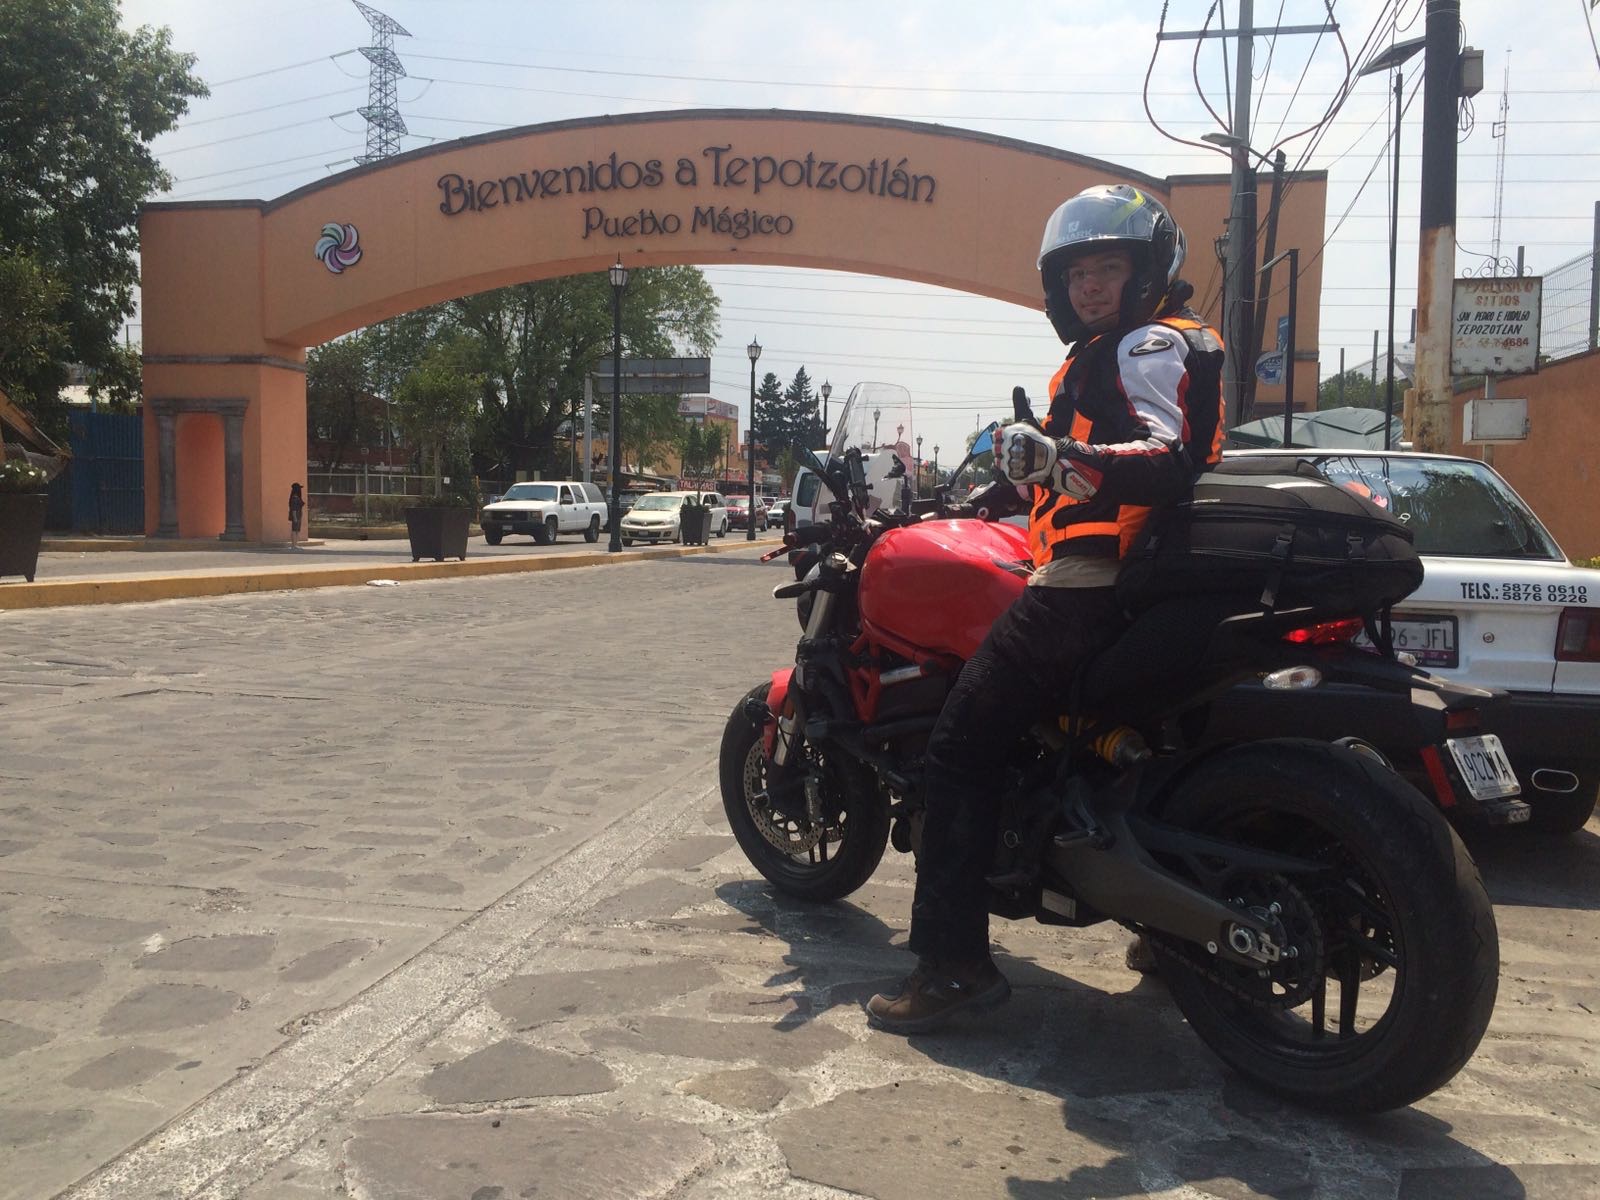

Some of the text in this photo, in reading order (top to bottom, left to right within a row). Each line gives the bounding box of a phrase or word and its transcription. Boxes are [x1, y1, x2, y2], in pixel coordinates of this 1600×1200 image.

[437, 143, 937, 216] Bienvenidos a Tepotzotlán
[582, 206, 794, 240] Pueblo Mágico
[1457, 311, 1472, 322] SAN
[1474, 311, 1495, 322] PEDRO
[1456, 323, 1523, 335] TEPOZOTLAN
[1502, 583, 1542, 592] 5876
[1547, 584, 1588, 594] 0610
[1502, 592, 1588, 604] 5876 0226
